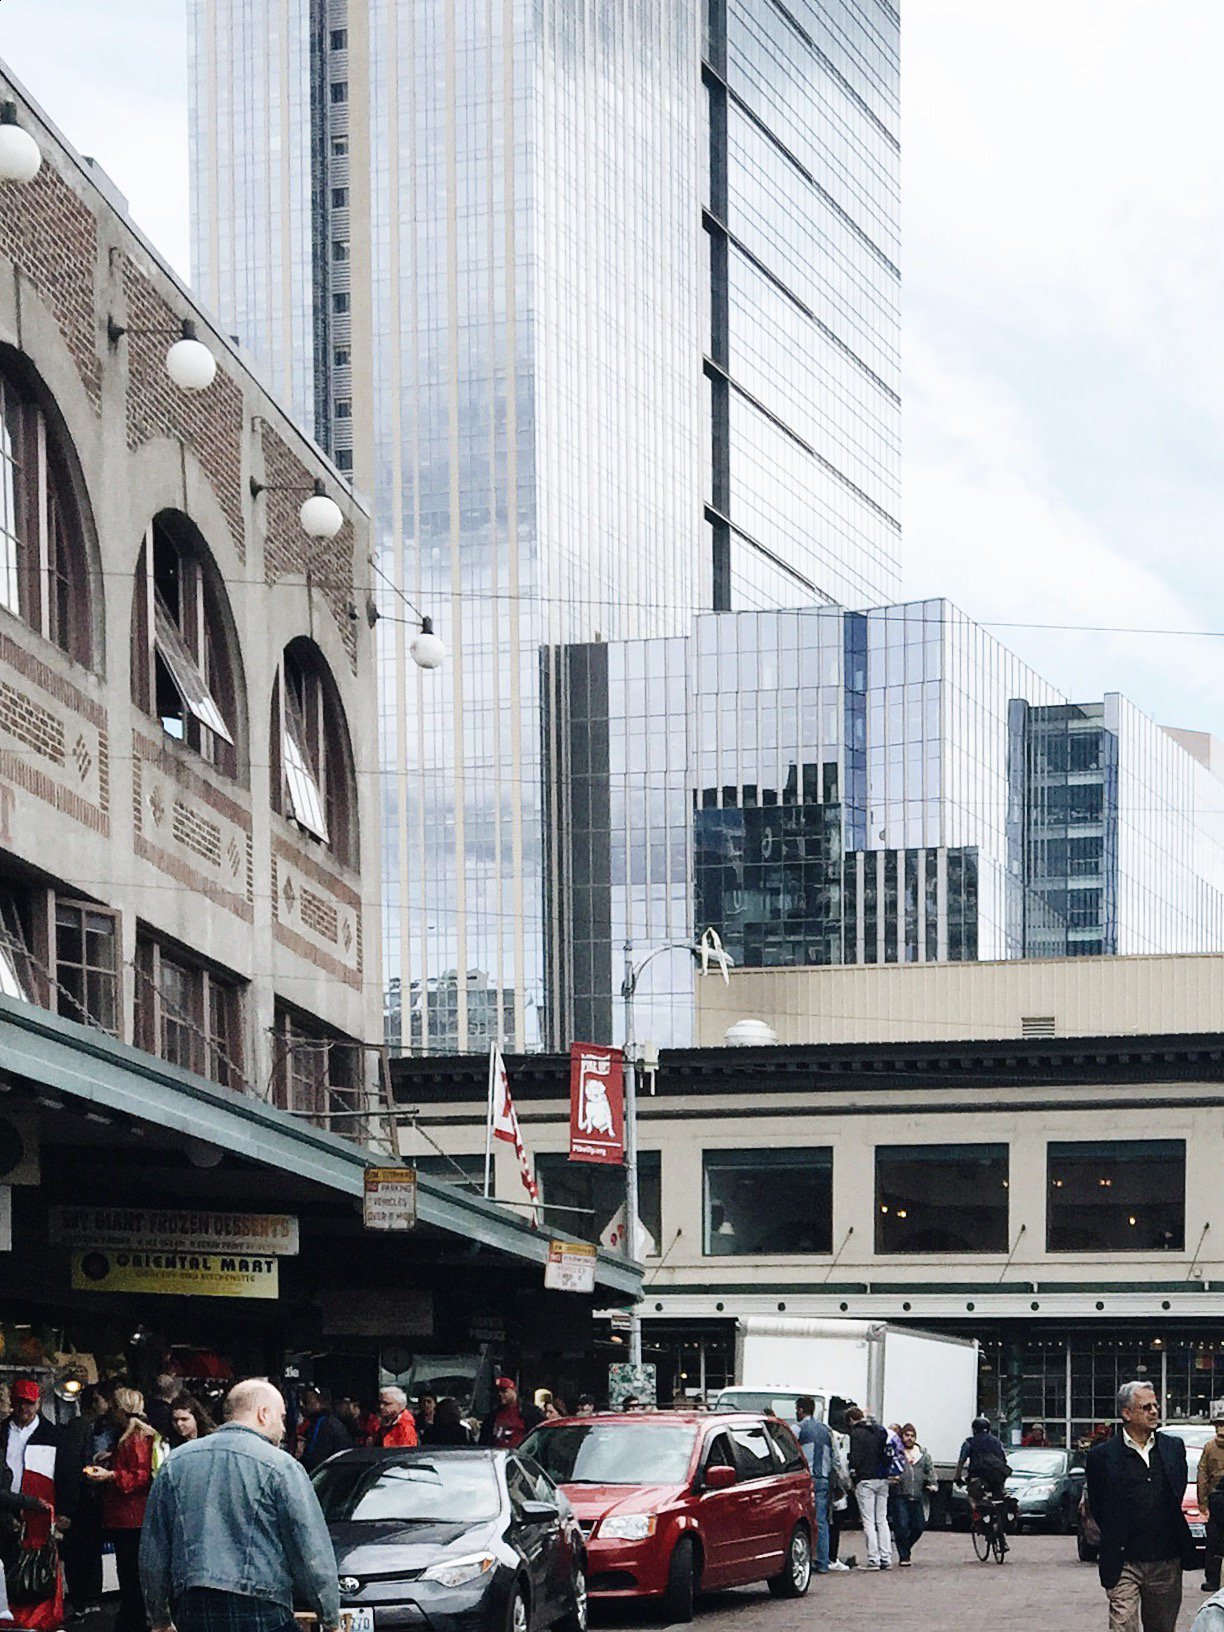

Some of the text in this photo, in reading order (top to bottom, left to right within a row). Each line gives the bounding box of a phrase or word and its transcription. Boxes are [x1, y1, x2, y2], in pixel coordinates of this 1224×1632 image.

[148, 1211, 210, 1236] FROZEN
[213, 1214, 291, 1239] DESSERTS
[116, 1253, 274, 1274] ORIENTAL MART
